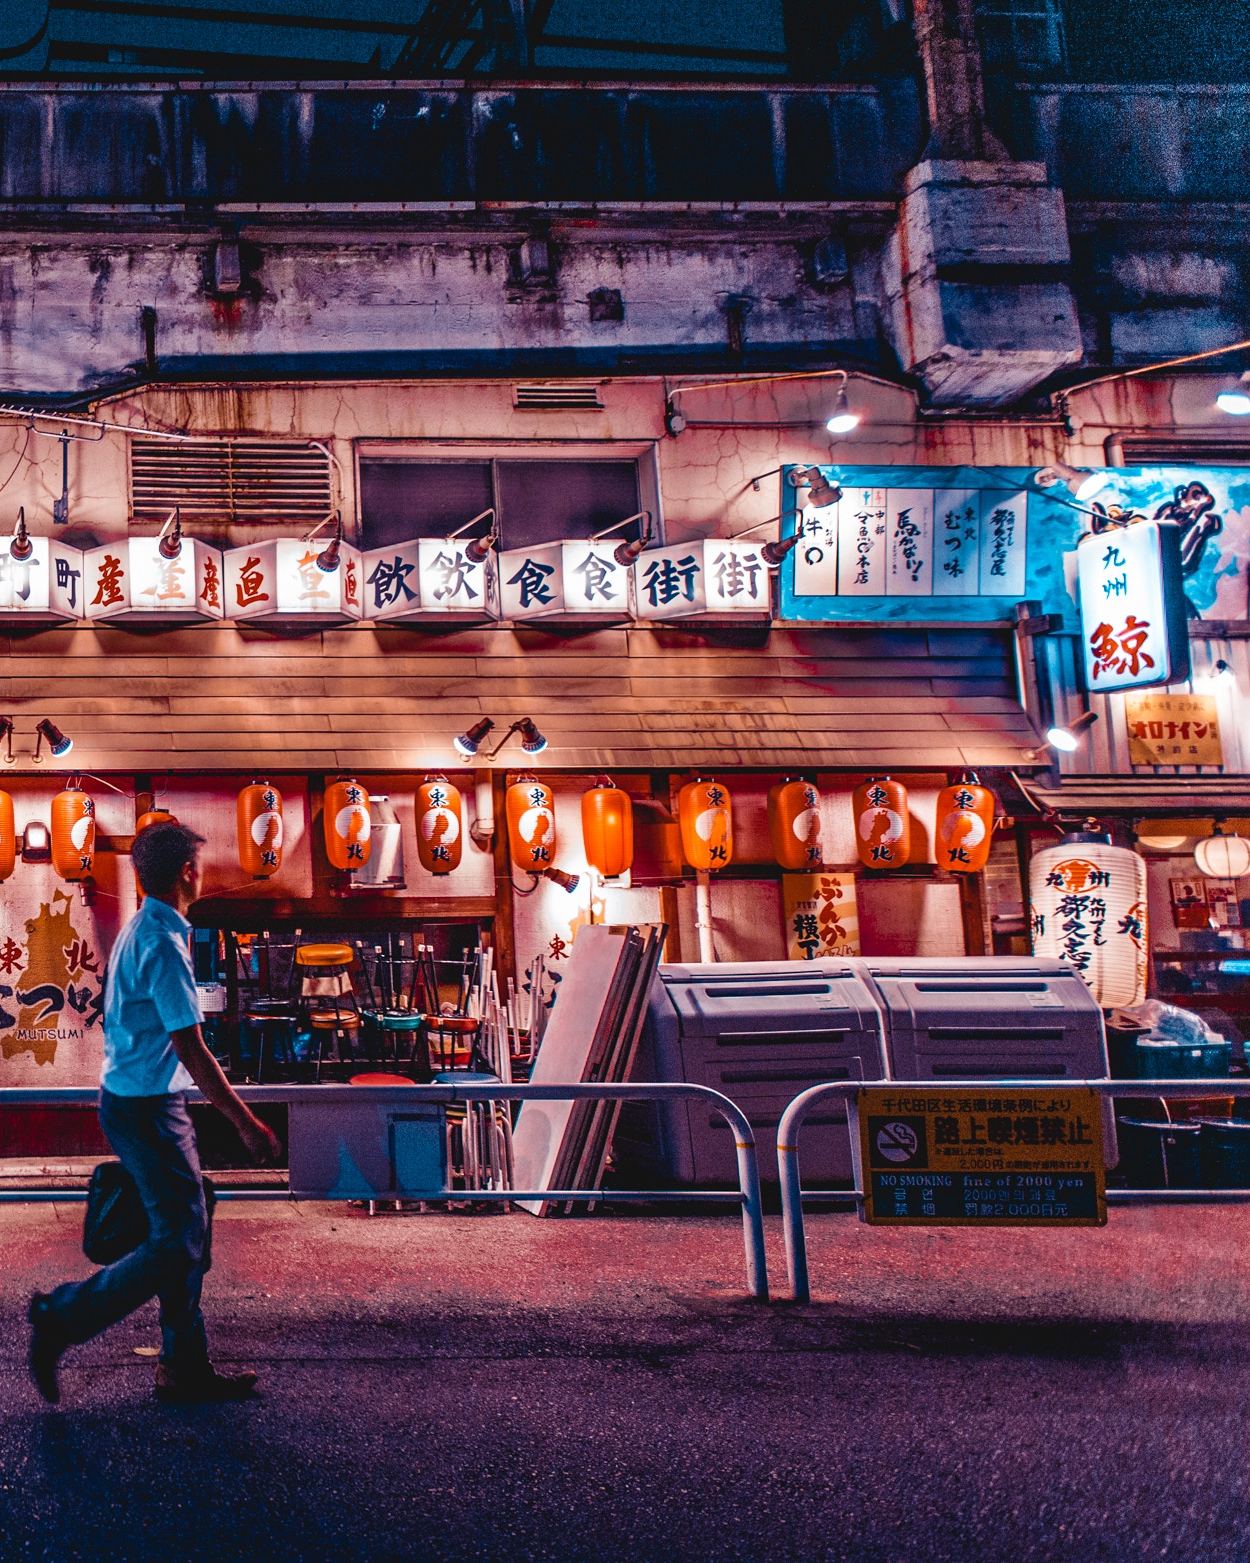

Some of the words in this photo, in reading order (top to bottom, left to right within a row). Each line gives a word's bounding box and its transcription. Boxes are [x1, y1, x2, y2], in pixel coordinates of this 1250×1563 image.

[943, 510, 964, 578] むつ味
[963, 507, 977, 541] 東北
[56, 558, 81, 609] 町
[89, 553, 126, 607] 産
[199, 555, 220, 610] 産
[235, 556, 269, 609] 直
[367, 553, 415, 606] 飲
[506, 558, 558, 608] 食
[572, 551, 619, 601] 食
[641, 554, 699, 608] 街
[713, 551, 761, 600] 街
[1102, 545, 1127, 600] 九州
[1090, 615, 1155, 680] 鯨
[1131, 721, 1208, 740] オロナイン
[1046, 871, 1111, 887] 九州
[793, 914, 820, 960] 横丁
[813, 877, 847, 947] ぶんか
[549, 933, 570, 960] 東
[16, 1028, 85, 1040] MUTSUMI
[882, 1098, 1071, 1113] 千代田区生活環境条例により
[934, 1116, 1093, 1146] 路上喫煙禁止
[880, 1175, 897, 1186] NO
[899, 1175, 953, 1186] SMOKING
[963, 1176, 991, 1186] fine
[996, 1176, 1011, 1186] of
[1016, 1176, 1053, 1187] 2000
[1058, 1178, 1084, 1190] yen
